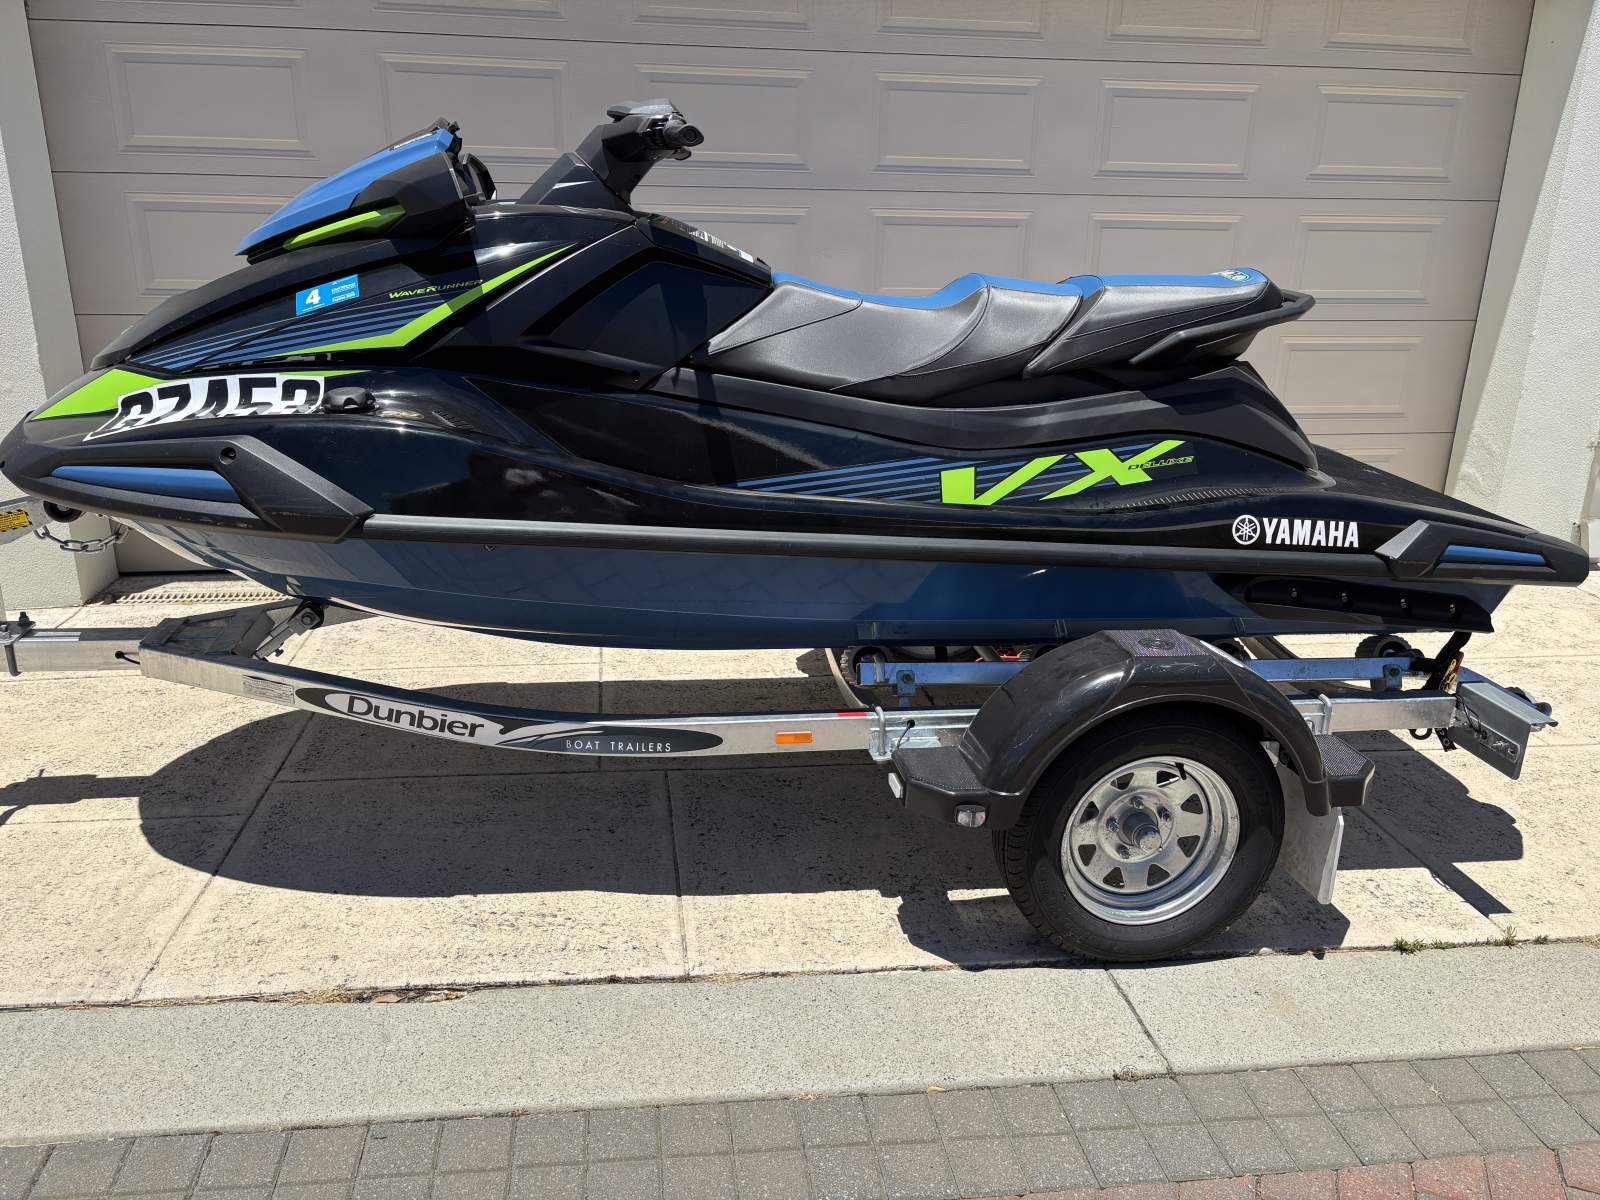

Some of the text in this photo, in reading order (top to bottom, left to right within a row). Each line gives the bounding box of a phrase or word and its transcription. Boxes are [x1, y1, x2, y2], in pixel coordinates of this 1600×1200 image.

[305, 288, 322, 305] 4
[940, 440, 1186, 506] VX
[1128, 456, 1195, 471] DELUXE
[1263, 517, 1359, 548] YAMAHA
[347, 695, 485, 738] Dunbier
[566, 740, 671, 753] BOAT TRAILERS
